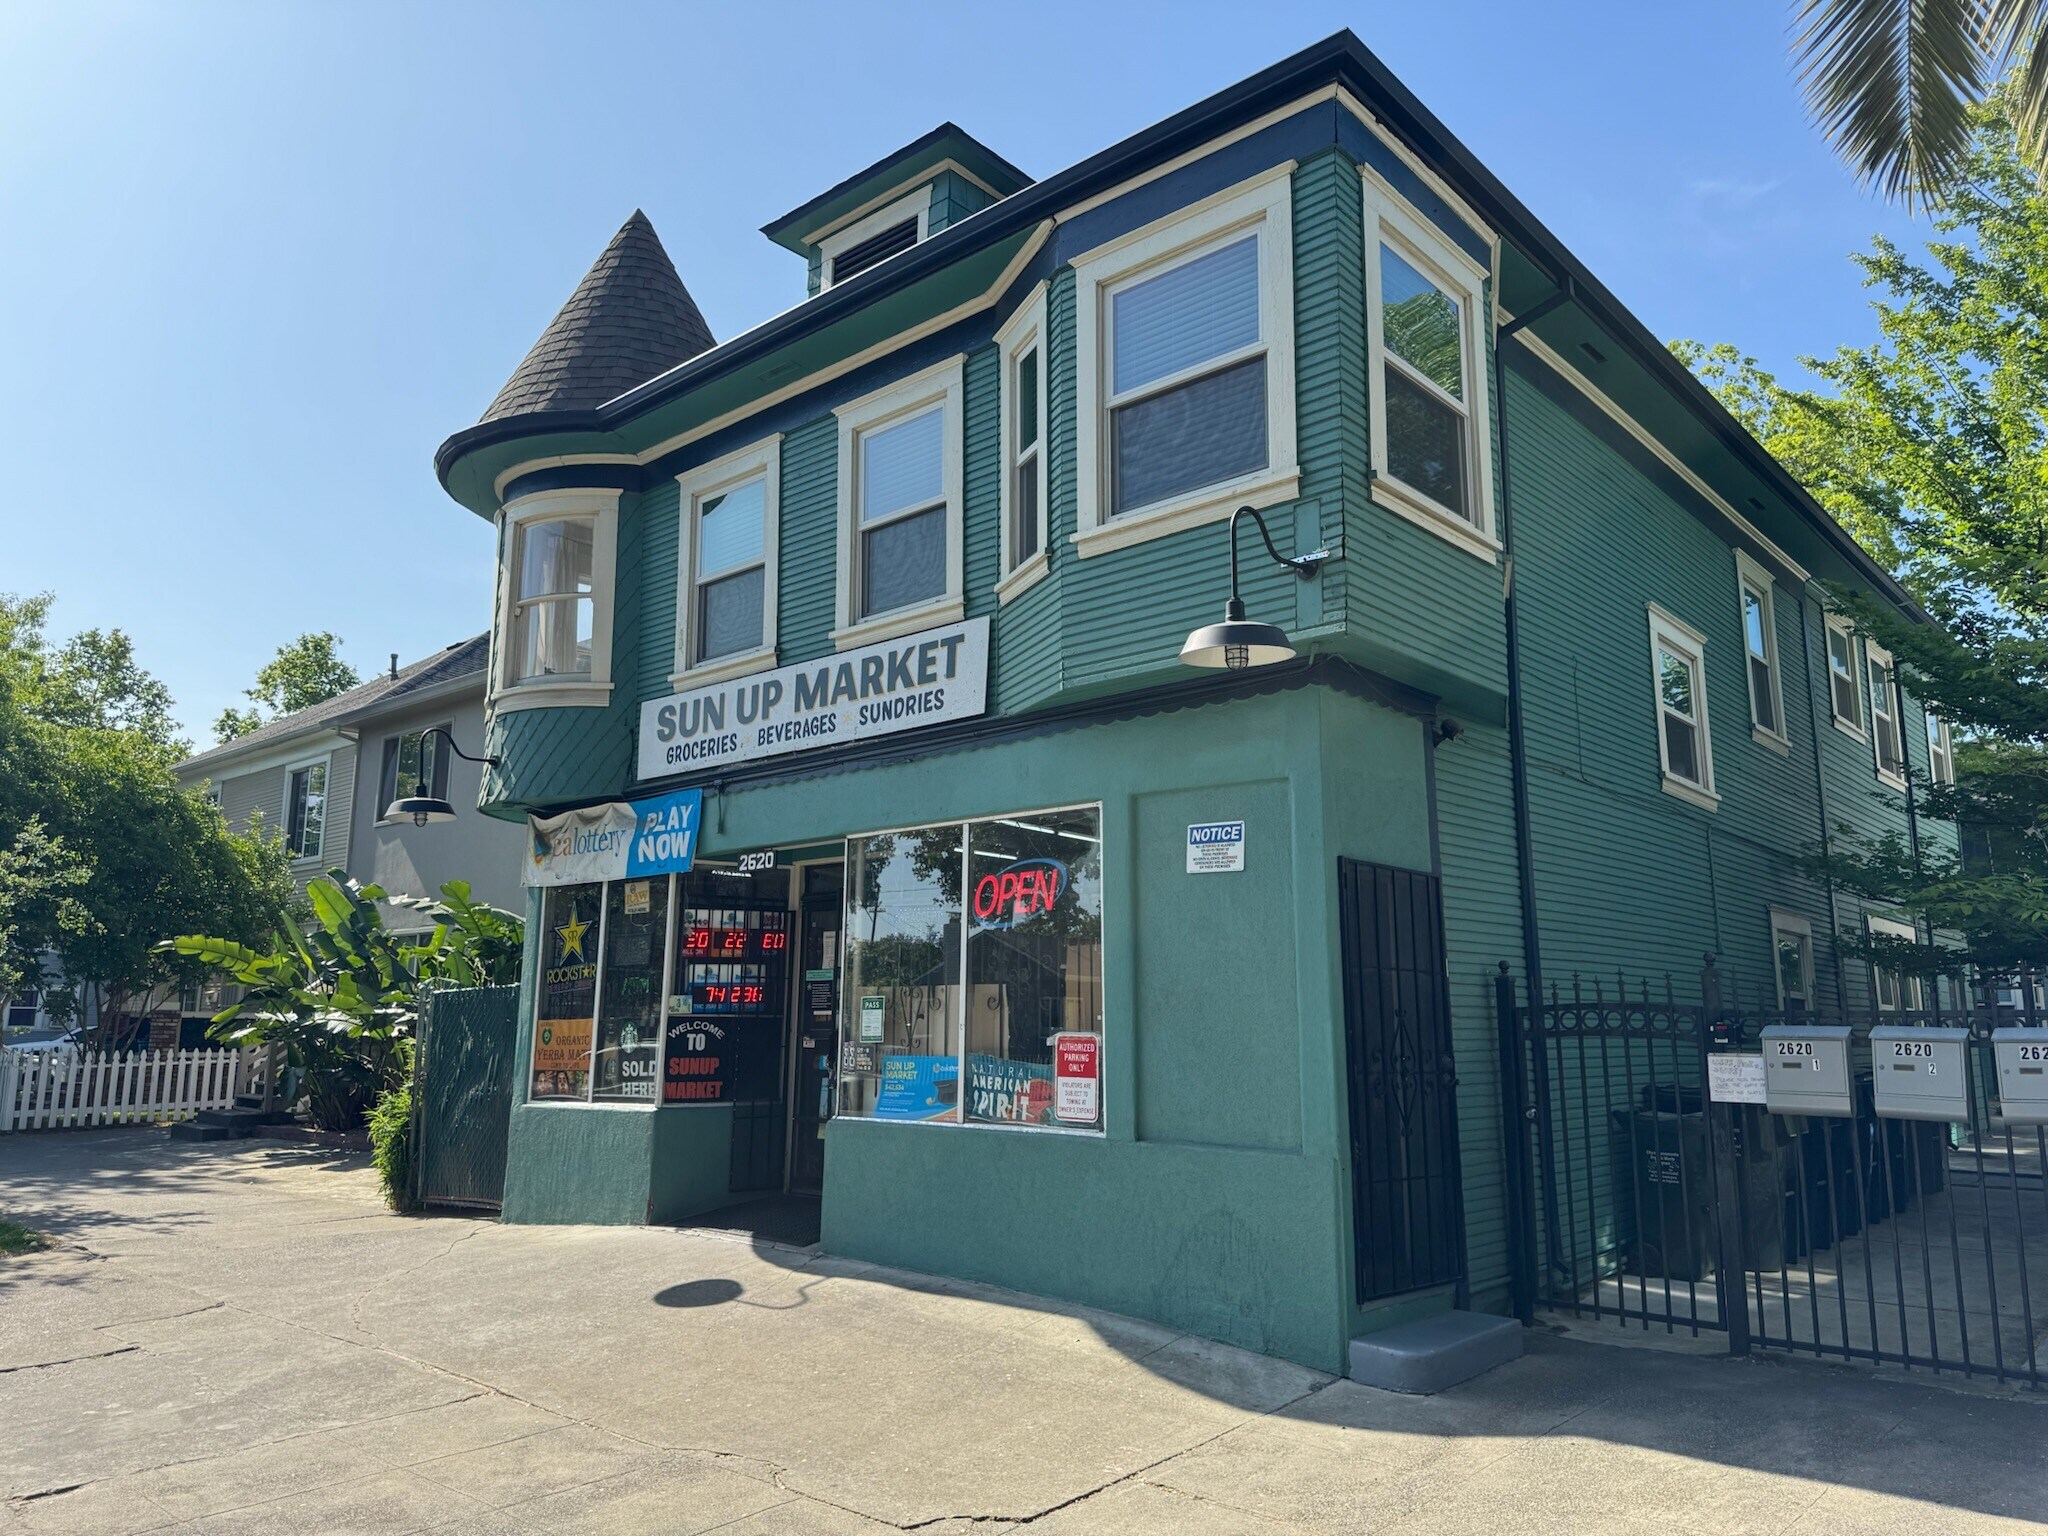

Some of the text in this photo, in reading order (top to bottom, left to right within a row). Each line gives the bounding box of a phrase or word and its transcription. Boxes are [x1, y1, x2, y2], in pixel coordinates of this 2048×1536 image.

[656, 633, 966, 743] SUN UP MARKET
[666, 688, 945, 765] GROCERIES BEVERAGES SUNDRIES
[643, 804, 694, 835] PLAY
[552, 826, 627, 858] calottery
[1191, 826, 1242, 842] NOTICE
[638, 831, 691, 863] NOW
[739, 851, 775, 871] 2620
[626, 890, 648, 904] RAW
[974, 867, 1059, 917] OPEN
[865, 1001, 880, 1009] PASS
[668, 1020, 726, 1041] WELCOME
[556, 1034, 590, 1046] ORGANIC
[686, 1033, 706, 1051] TO
[1058, 1043, 1095, 1053] AUTHORIZED
[537, 1048, 565, 1061] YERBA
[1778, 1043, 1813, 1055] 2620
[1895, 1043, 1932, 1057] 2620
[886, 1061, 915, 1070] SUN UP
[1064, 1053, 1090, 1062] PARKING
[1814, 1060, 1819, 1071] 1
[622, 1060, 657, 1077] SOLD
[669, 1057, 720, 1075] SUNUP
[971, 1063, 1033, 1079] NATURAL
[1068, 1063, 1085, 1072] ONLY
[1929, 1063, 1936, 1075] 2
[886, 1071, 918, 1080] MARKET
[622, 1081, 657, 1096] HERE
[663, 1081, 724, 1099] MARKET
[973, 1074, 1031, 1094] AMERICAN
[973, 1090, 1034, 1121] SPIRIT
